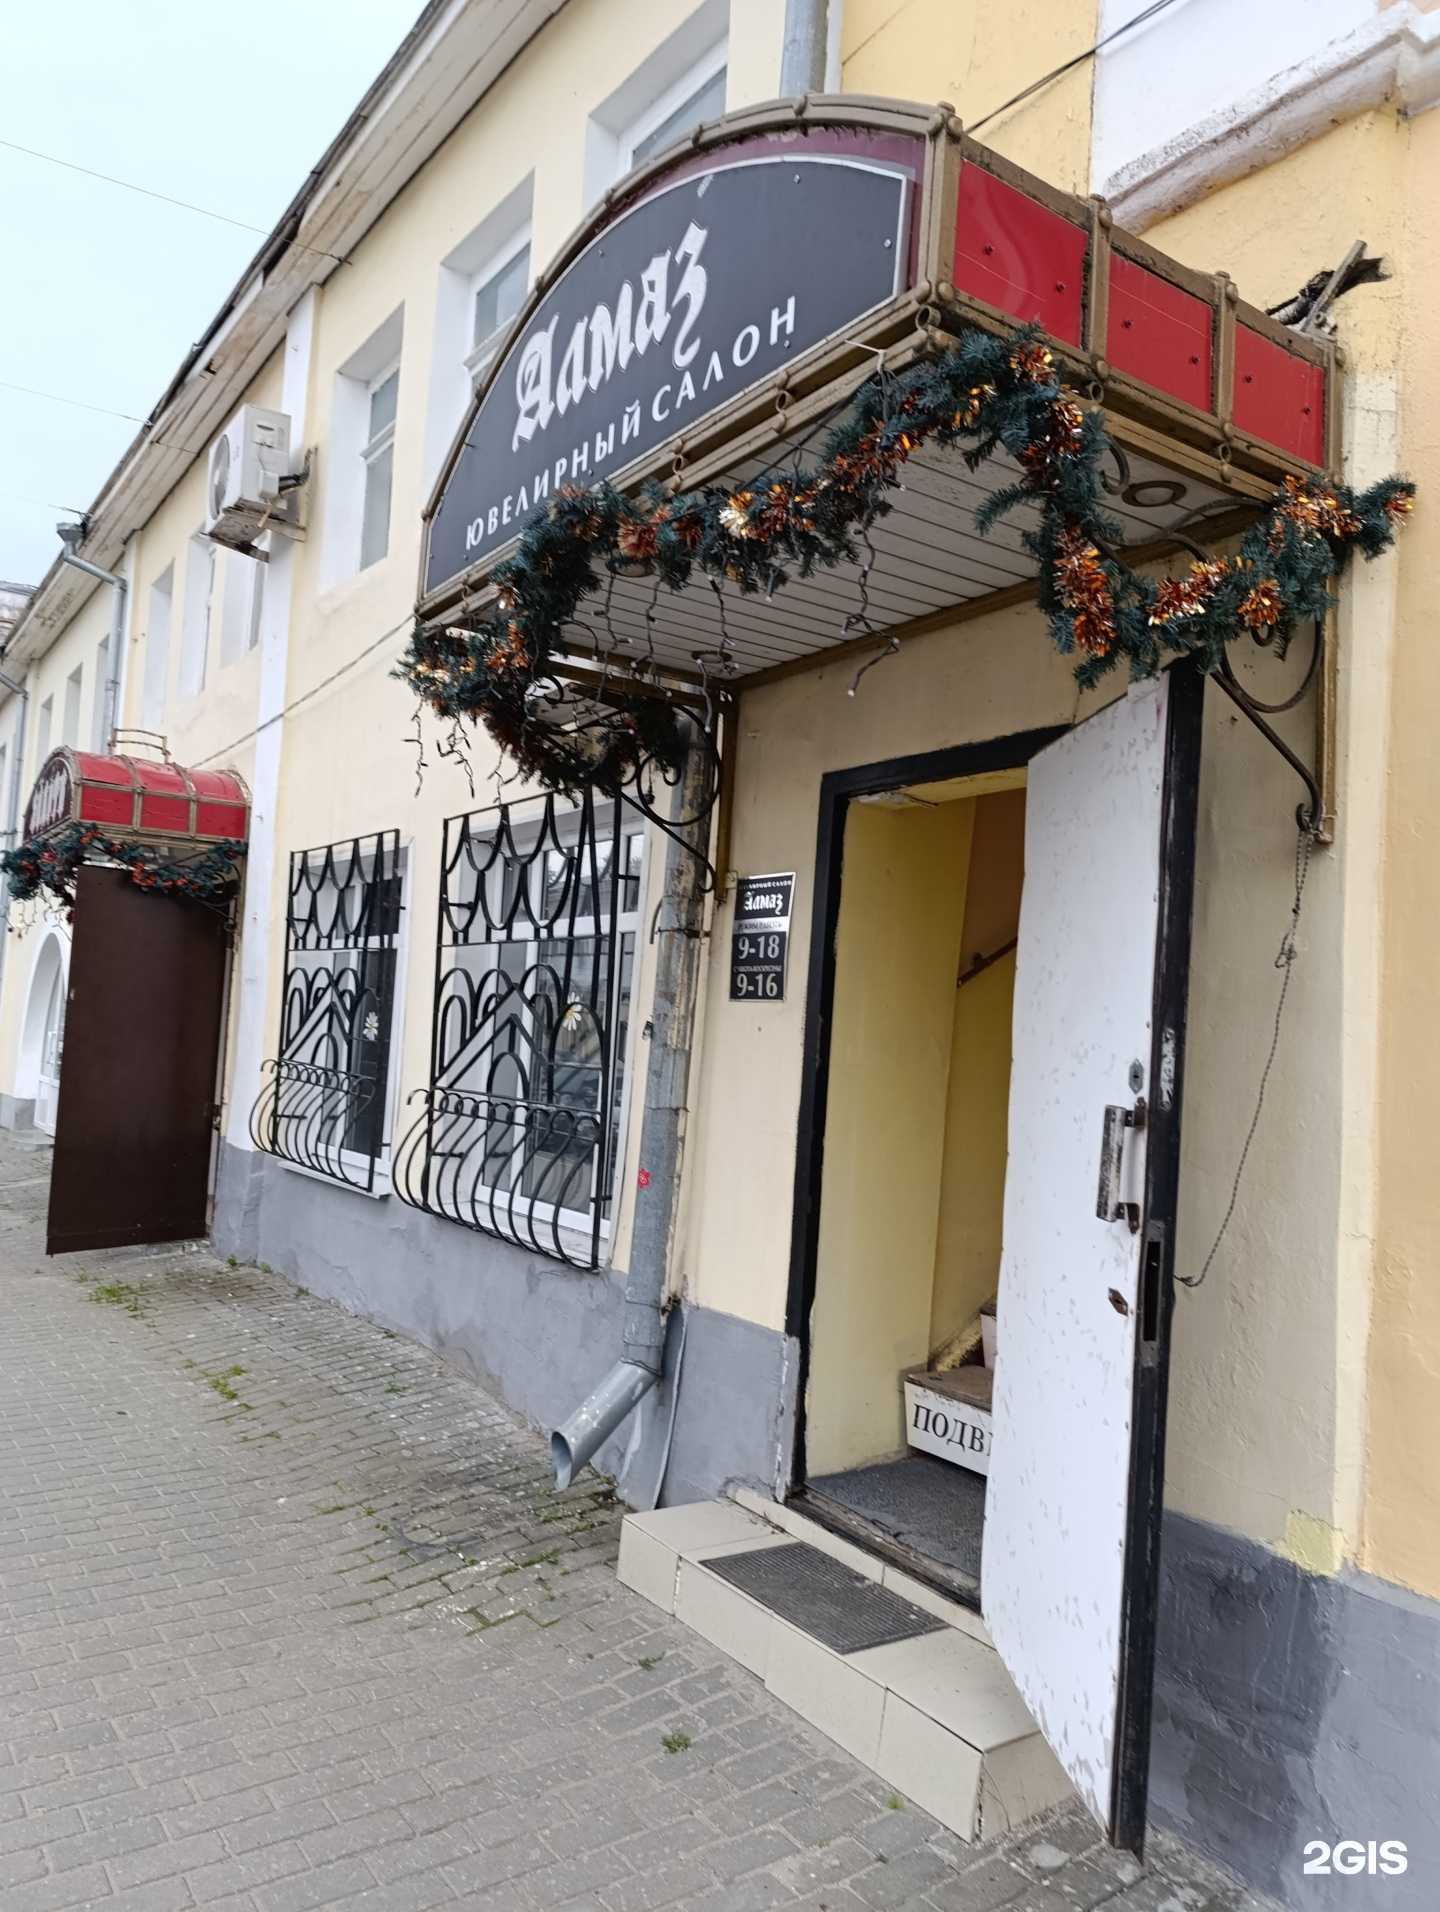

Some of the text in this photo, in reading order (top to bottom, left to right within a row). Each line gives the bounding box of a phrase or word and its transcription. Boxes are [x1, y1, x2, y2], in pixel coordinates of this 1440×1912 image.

[465, 296, 796, 551] ЮВЕЛИРНЫЙ САЛОН
[738, 935, 780, 959] 9-18
[736, 973, 778, 997] 9-16
